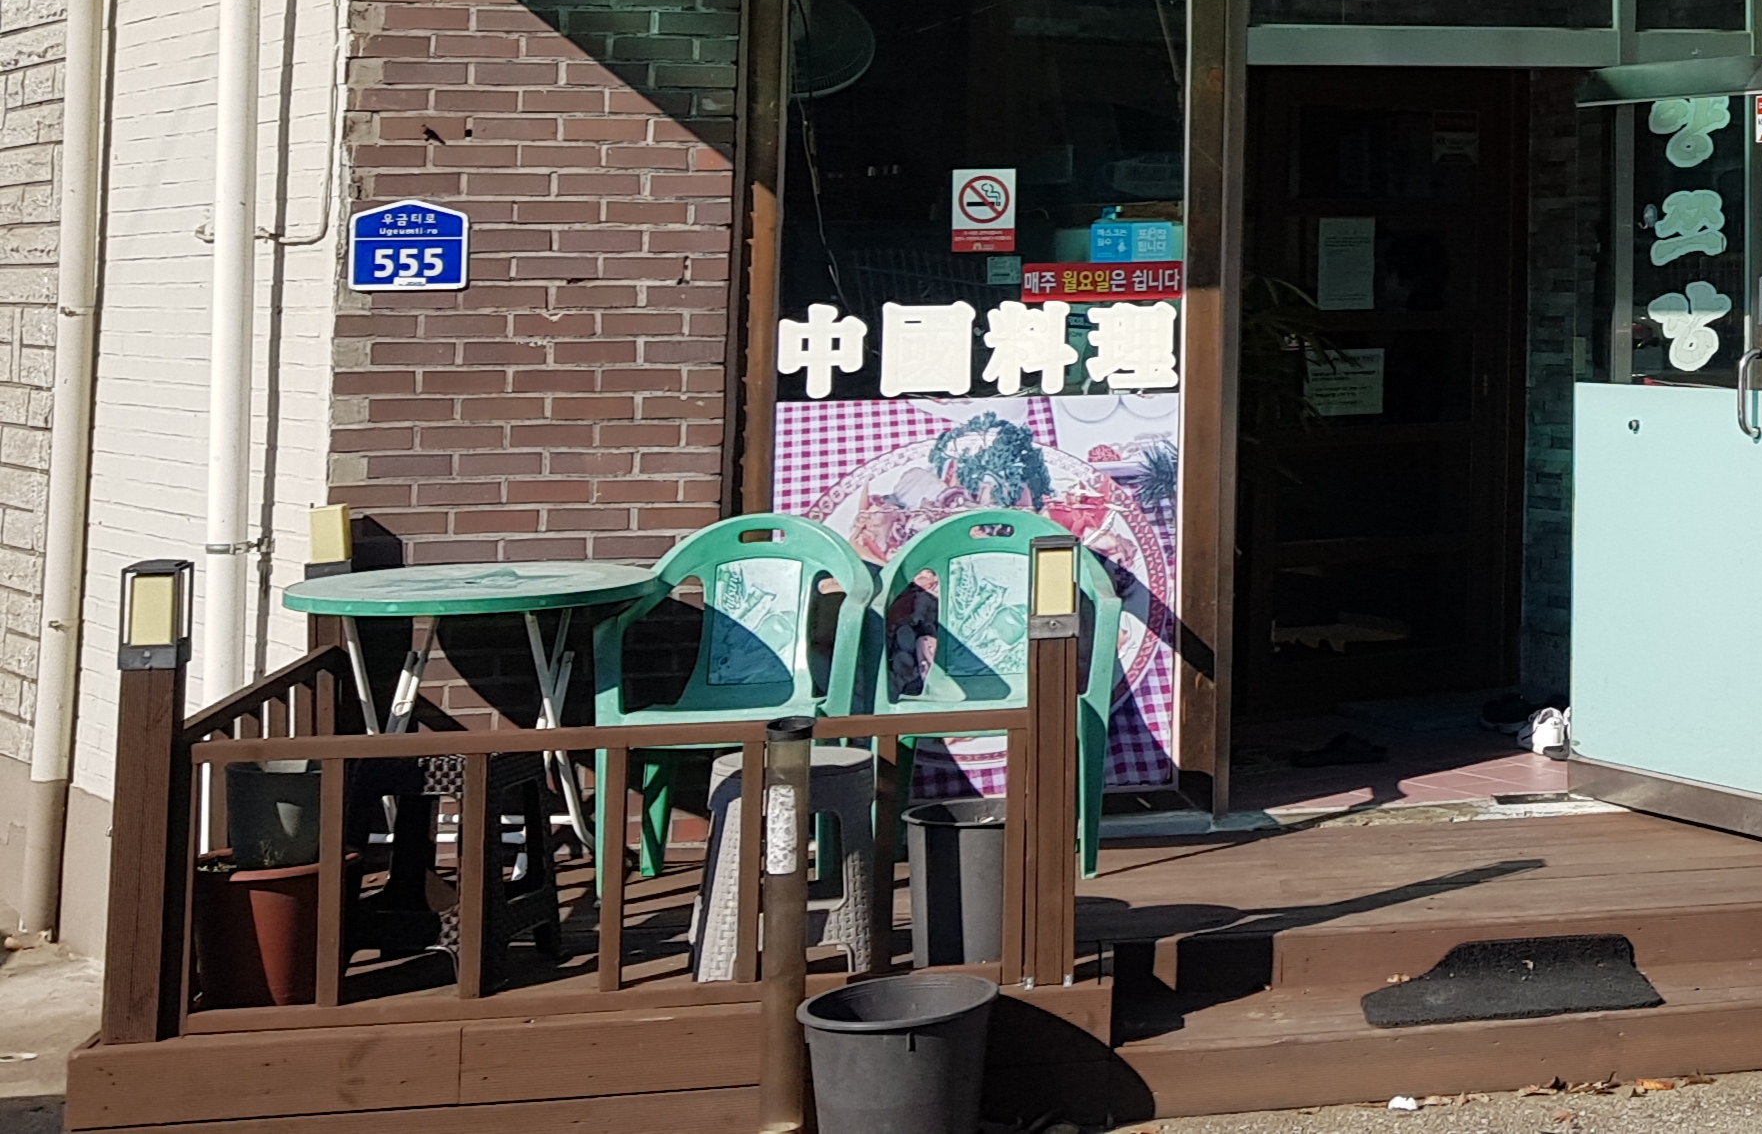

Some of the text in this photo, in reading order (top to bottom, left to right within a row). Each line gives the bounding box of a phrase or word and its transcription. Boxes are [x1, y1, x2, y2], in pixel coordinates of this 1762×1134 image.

[381, 213, 437, 227] 우금티로
[1647, 96, 1732, 372] 양쯔강
[373, 247, 444, 279] 555
[1023, 270, 1057, 293] 매주
[1061, 269, 1127, 294] 월요일은
[1131, 268, 1181, 293] 쉽니다
[777, 299, 1180, 399] 中國料理
